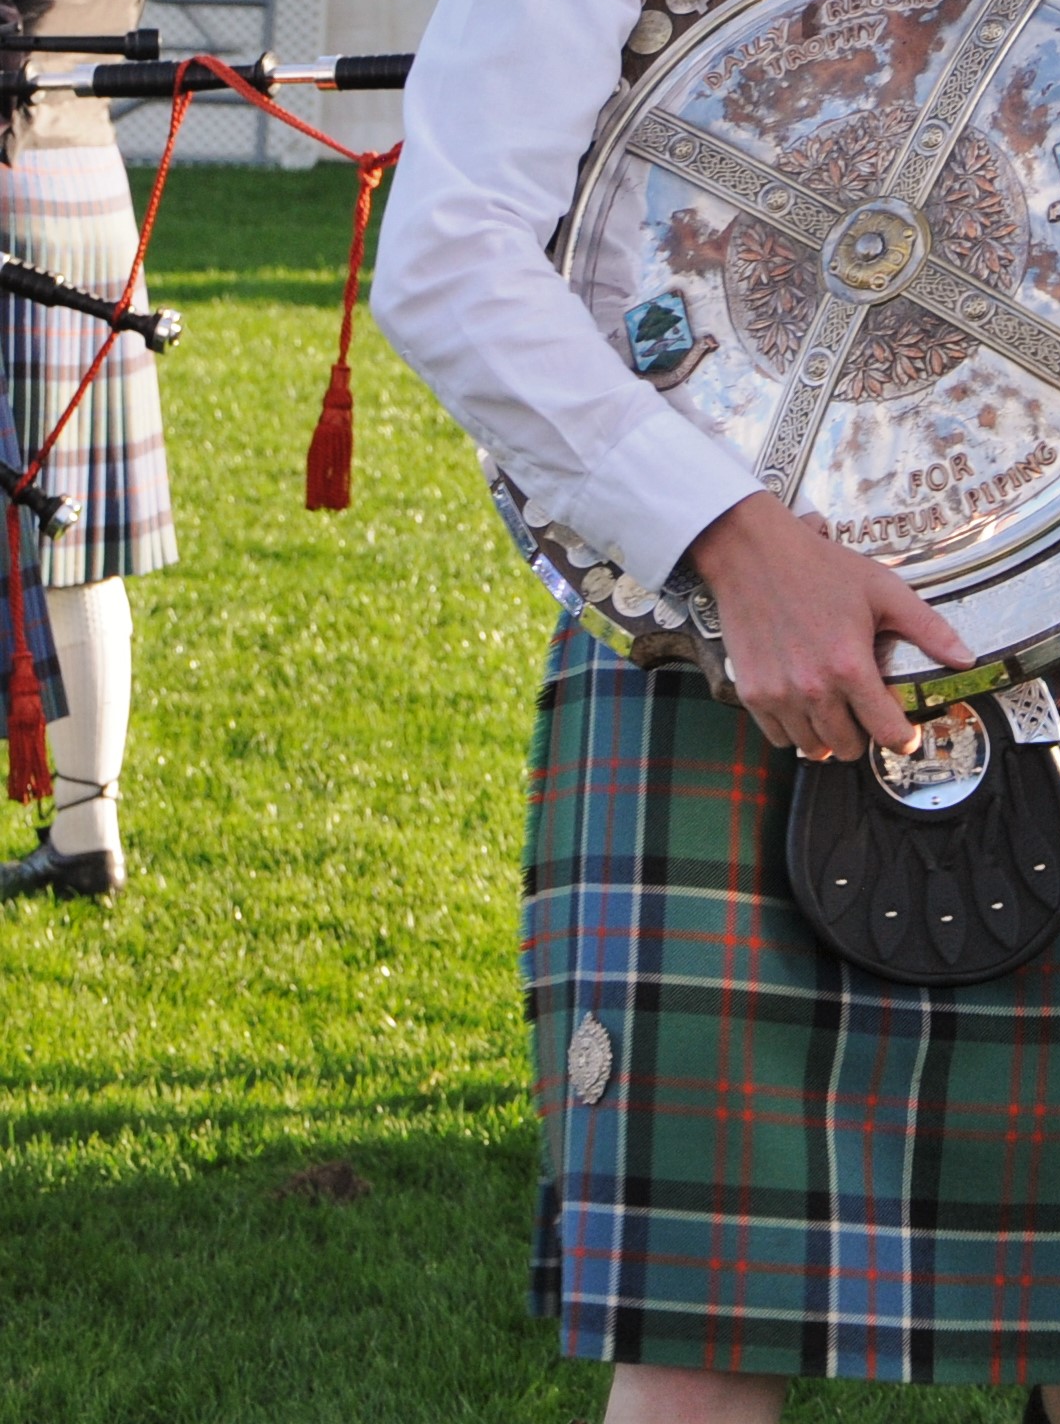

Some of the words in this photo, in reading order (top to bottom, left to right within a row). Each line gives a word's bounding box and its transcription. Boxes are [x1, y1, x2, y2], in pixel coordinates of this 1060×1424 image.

[705, 20, 788, 89] DAILY
[767, 20, 884, 76] TROPHY
[818, 503, 947, 544] AMATEUR
[964, 441, 1058, 513] PIPING
[907, 452, 974, 499] FOR
